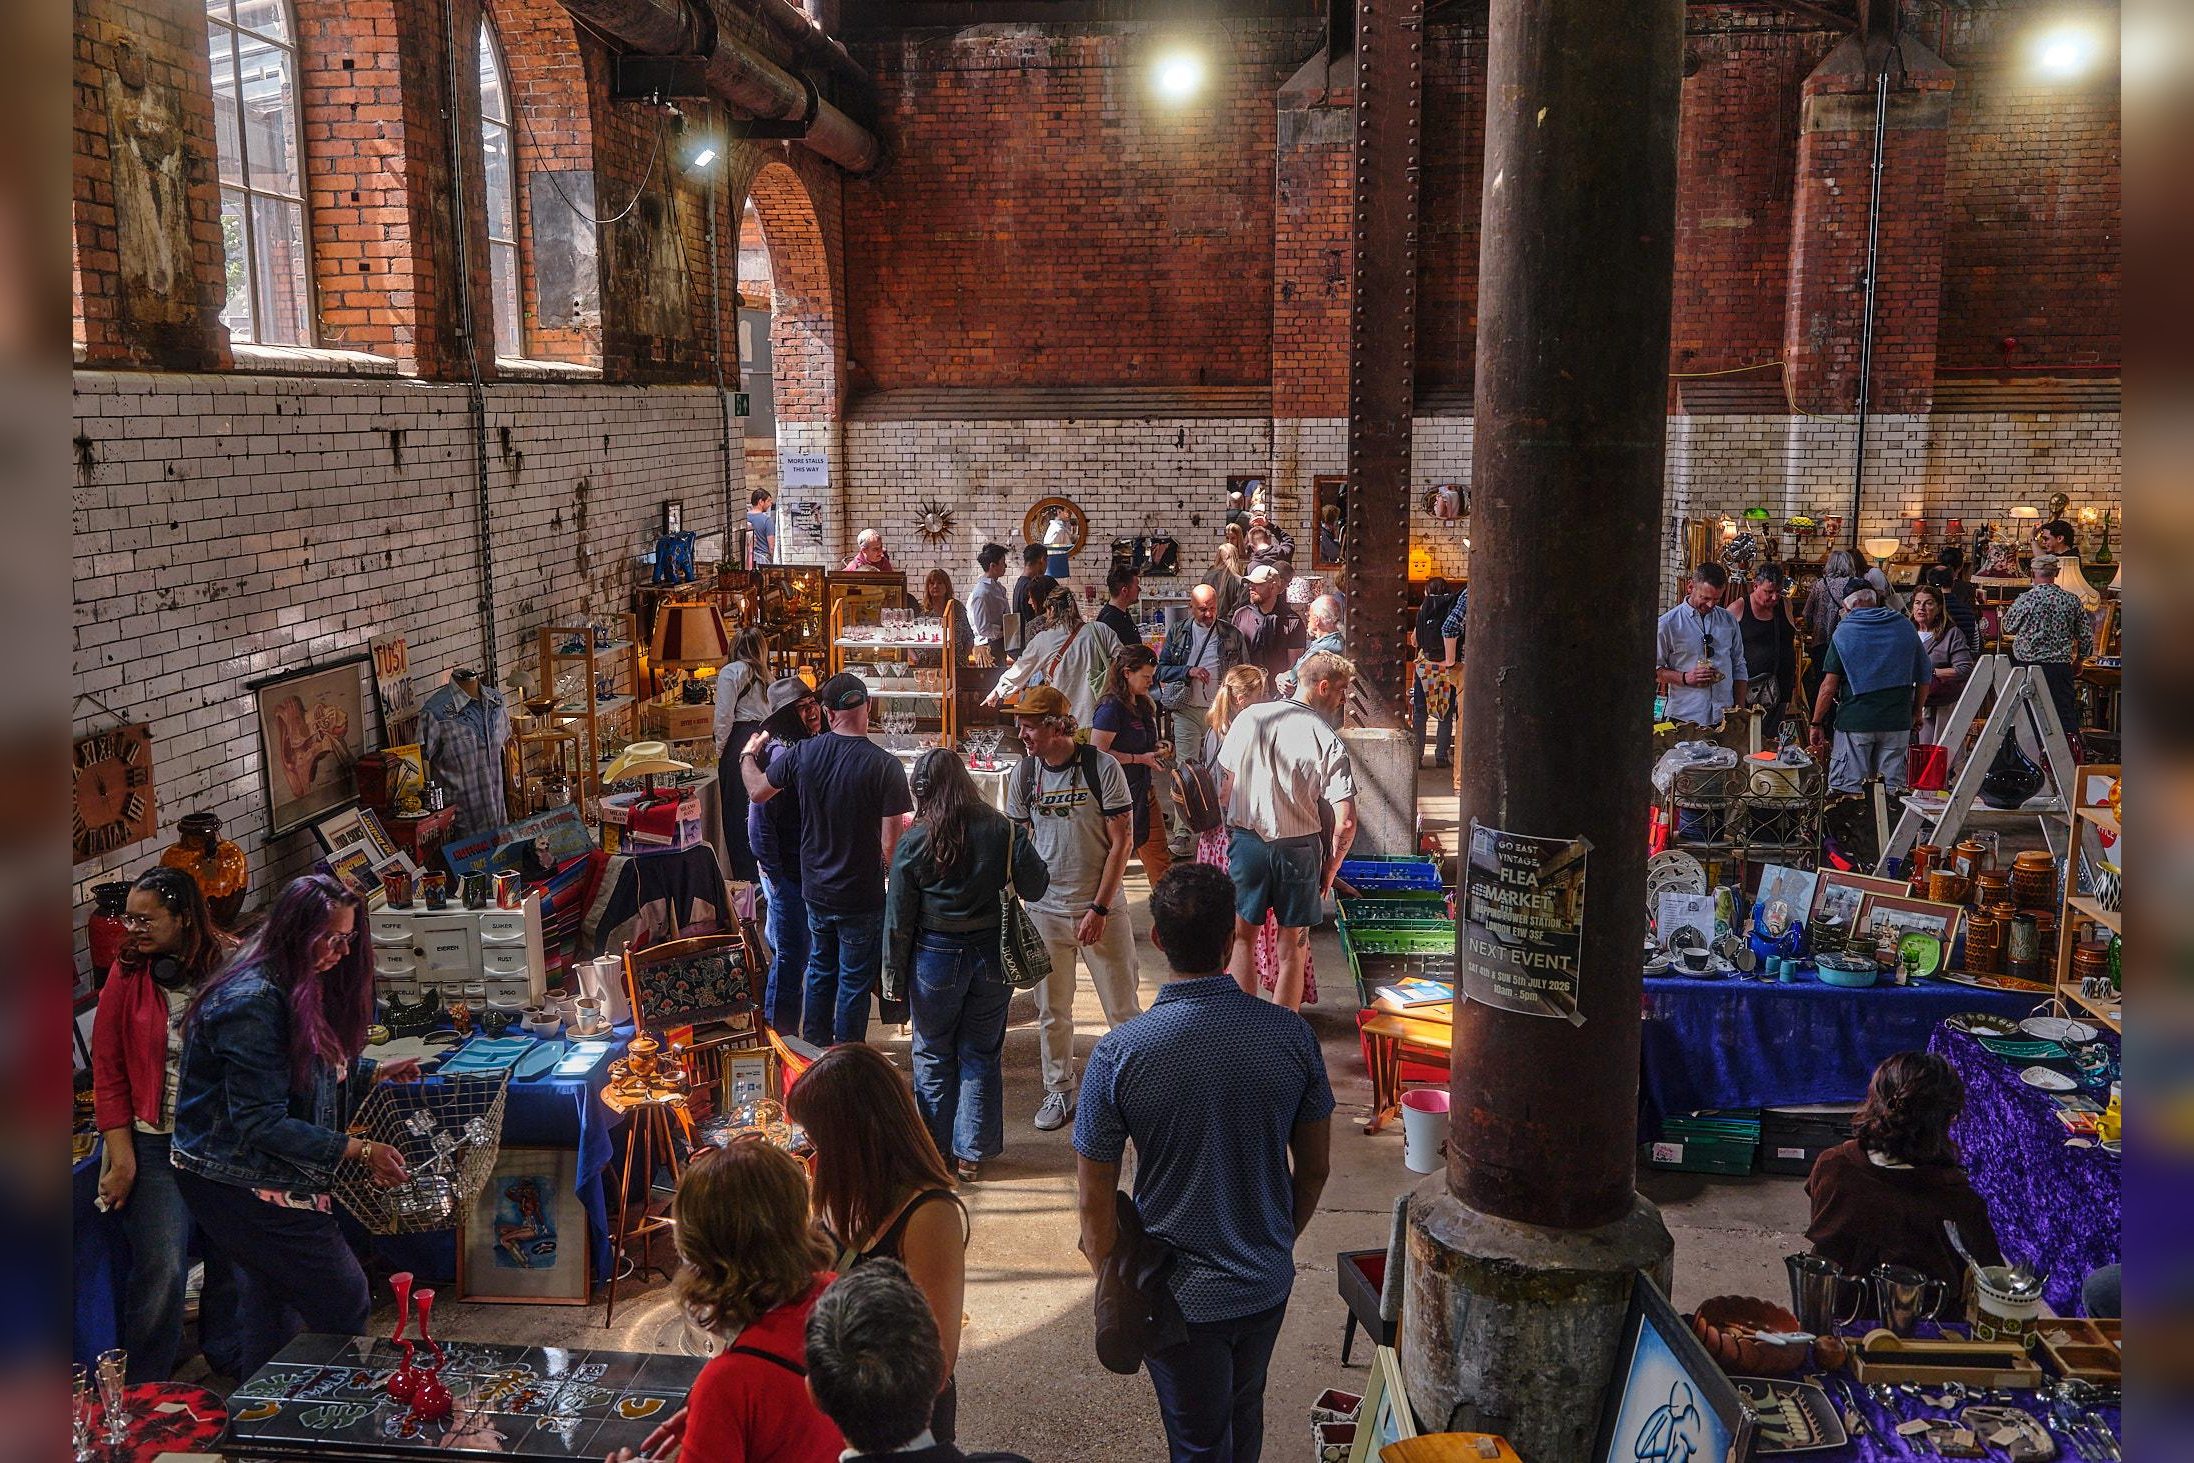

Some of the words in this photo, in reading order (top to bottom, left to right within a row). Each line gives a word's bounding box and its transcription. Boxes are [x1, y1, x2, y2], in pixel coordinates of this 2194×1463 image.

[374, 638, 407, 678] JUST
[381, 676, 414, 717] SCORE
[1498, 841, 1514, 851] GO
[1515, 844, 1538, 854] EAST
[1500, 867, 1539, 888] FLEA
[1485, 884, 1551, 909] MARKET
[1001, 902, 1010, 940] DAUNT
[1474, 903, 1501, 920] WAPPING
[1501, 910, 1529, 925] POWER
[1485, 920, 1511, 934] LONDON
[1512, 926, 1528, 938] E1W
[1529, 930, 1545, 940] 3SF
[1001, 945, 1022, 981] BOOKS
[1469, 937, 1507, 961] NEXT
[1511, 949, 1572, 970] EVENT
[1468, 961, 1478, 973] SAT
[1479, 966, 1490, 978] 4th
[1491, 971, 1496, 980] &
[1497, 971, 1511, 984] SUN
[1513, 976, 1526, 987] 5th
[1528, 979, 1547, 990] JULY
[1548, 980, 1570, 991] 2026
[1493, 983, 1513, 997] 10am
[1519, 989, 1538, 1002] 5pm
